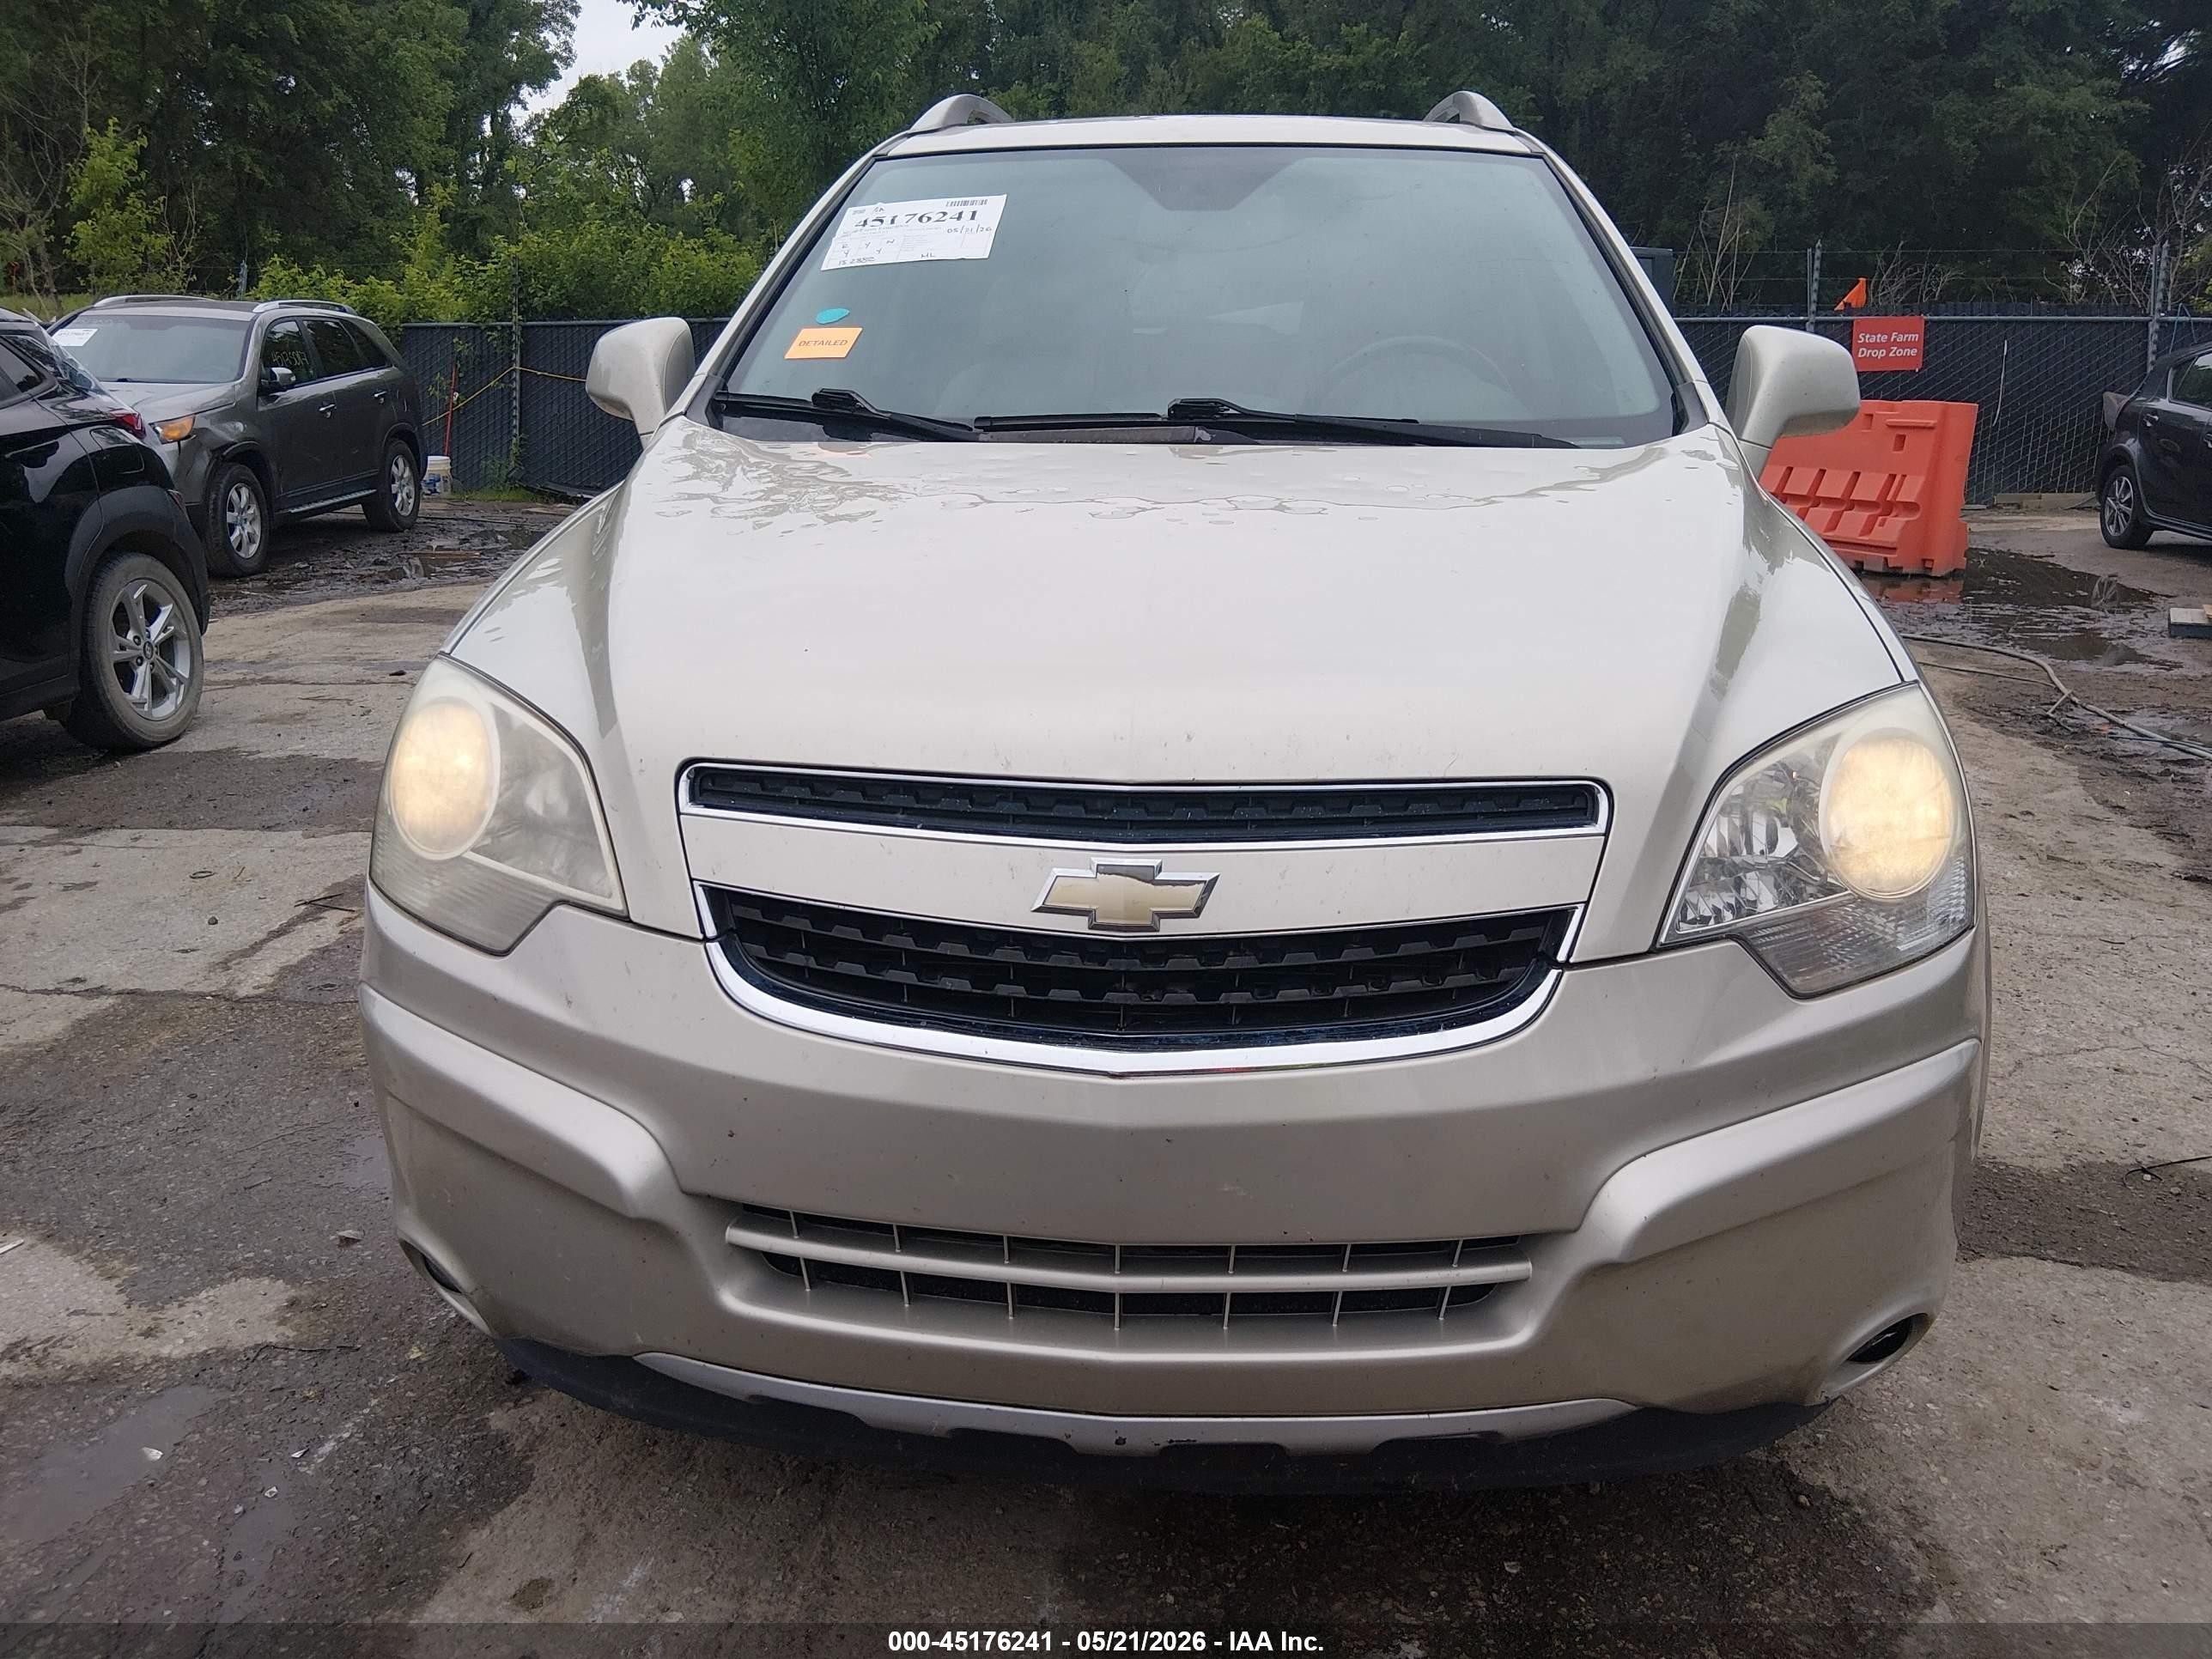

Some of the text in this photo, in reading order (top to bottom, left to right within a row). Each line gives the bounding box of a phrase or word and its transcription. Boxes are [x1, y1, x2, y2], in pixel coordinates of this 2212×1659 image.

[854, 210, 978, 228] 45176241
[1858, 332, 1918, 343] State Farm
[1858, 347, 1917, 359] Drop Zone
